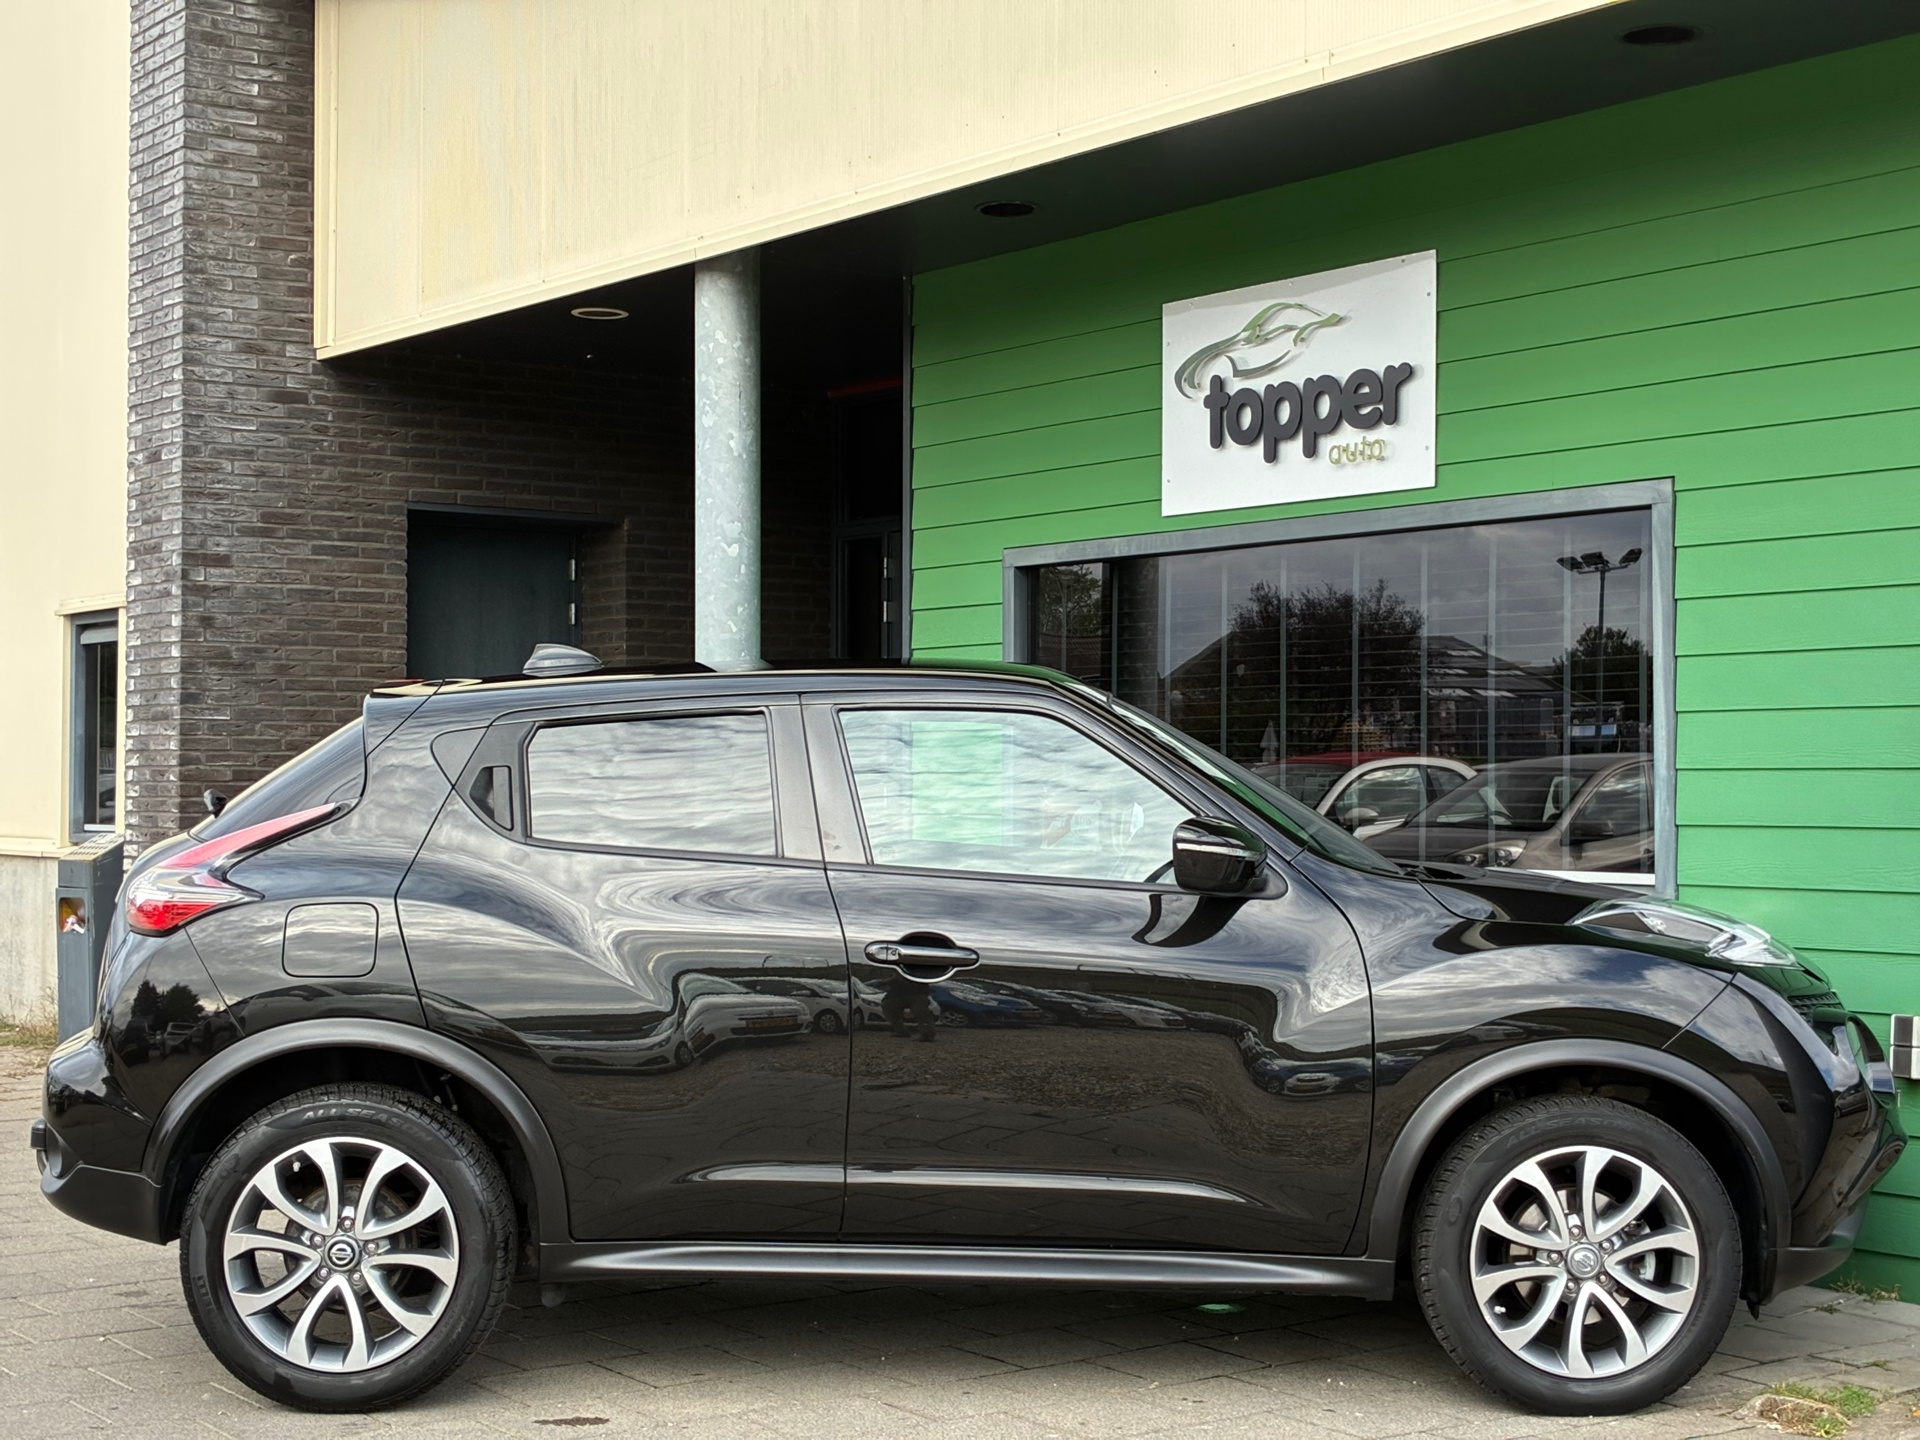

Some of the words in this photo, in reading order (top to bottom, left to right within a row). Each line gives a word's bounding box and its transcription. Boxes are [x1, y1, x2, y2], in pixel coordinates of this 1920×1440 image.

[1203, 362, 1413, 464] topper
[1329, 436, 1385, 465] auto
[345, 1108, 432, 1141] SEASON
